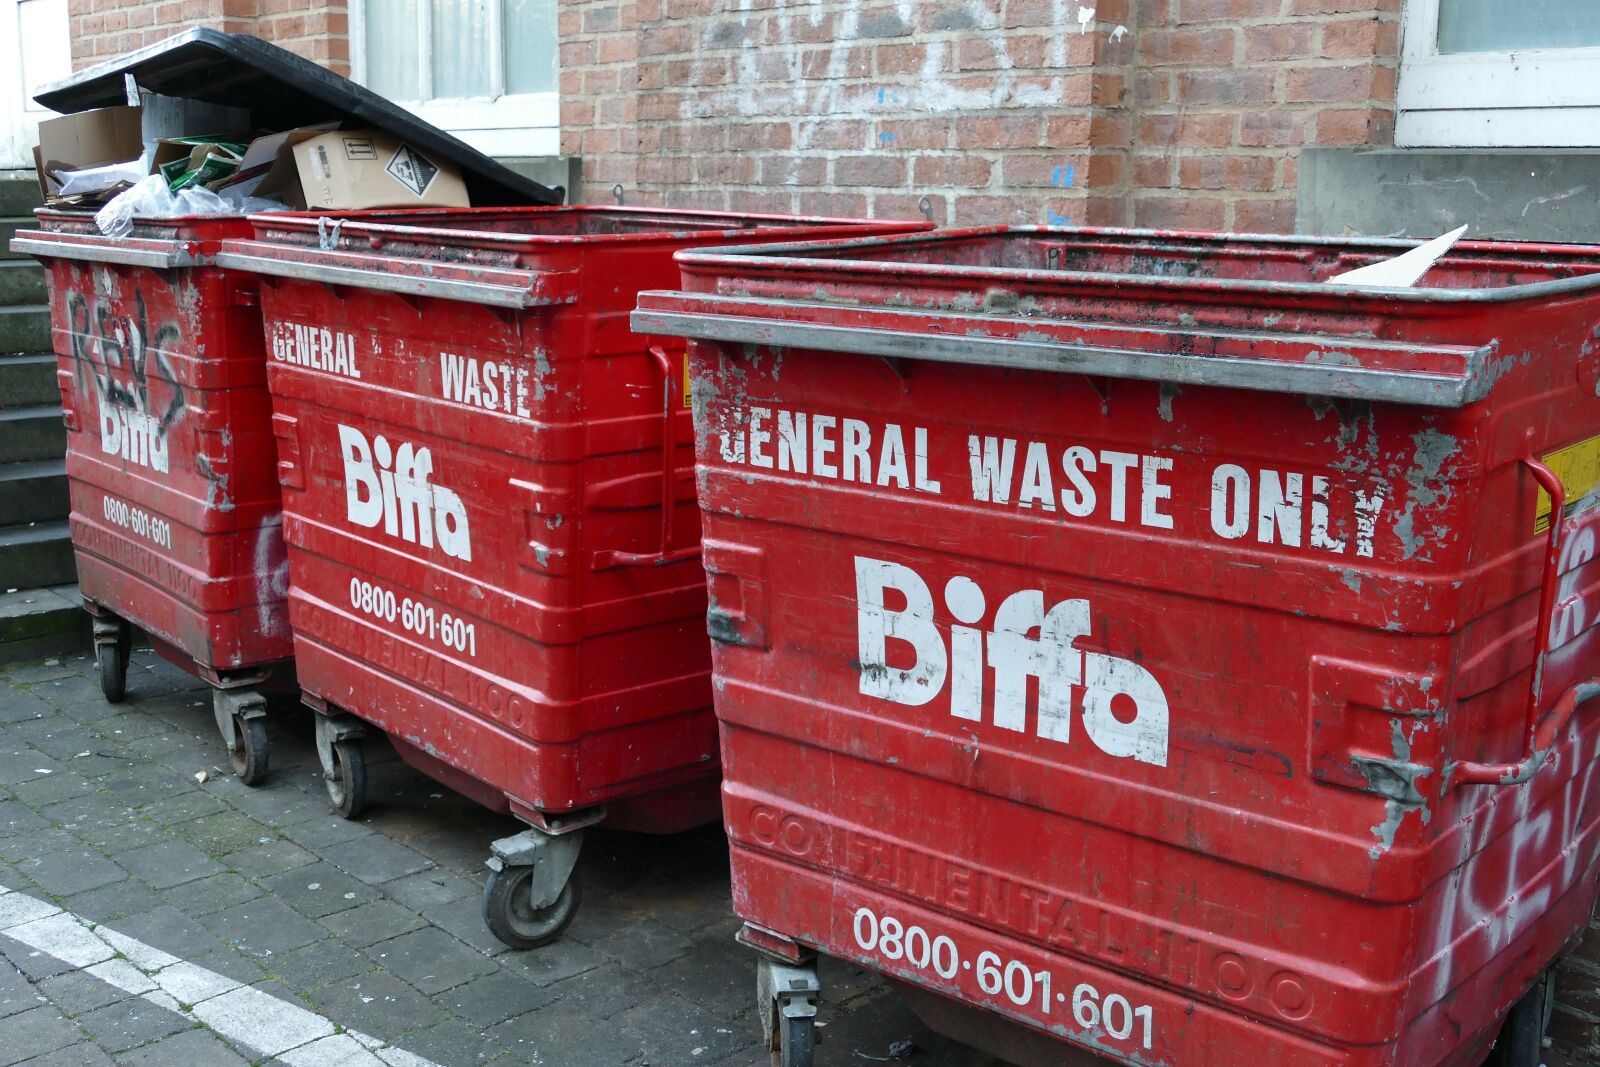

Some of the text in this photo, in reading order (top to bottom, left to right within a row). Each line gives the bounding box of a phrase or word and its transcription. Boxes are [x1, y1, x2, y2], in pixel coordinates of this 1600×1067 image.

[272, 322, 531, 418] GENERAL WASTE
[337, 423, 472, 562] Biffa
[719, 406, 1387, 558] GENERAL WASTE ONLY
[853, 555, 1170, 768] Biffa
